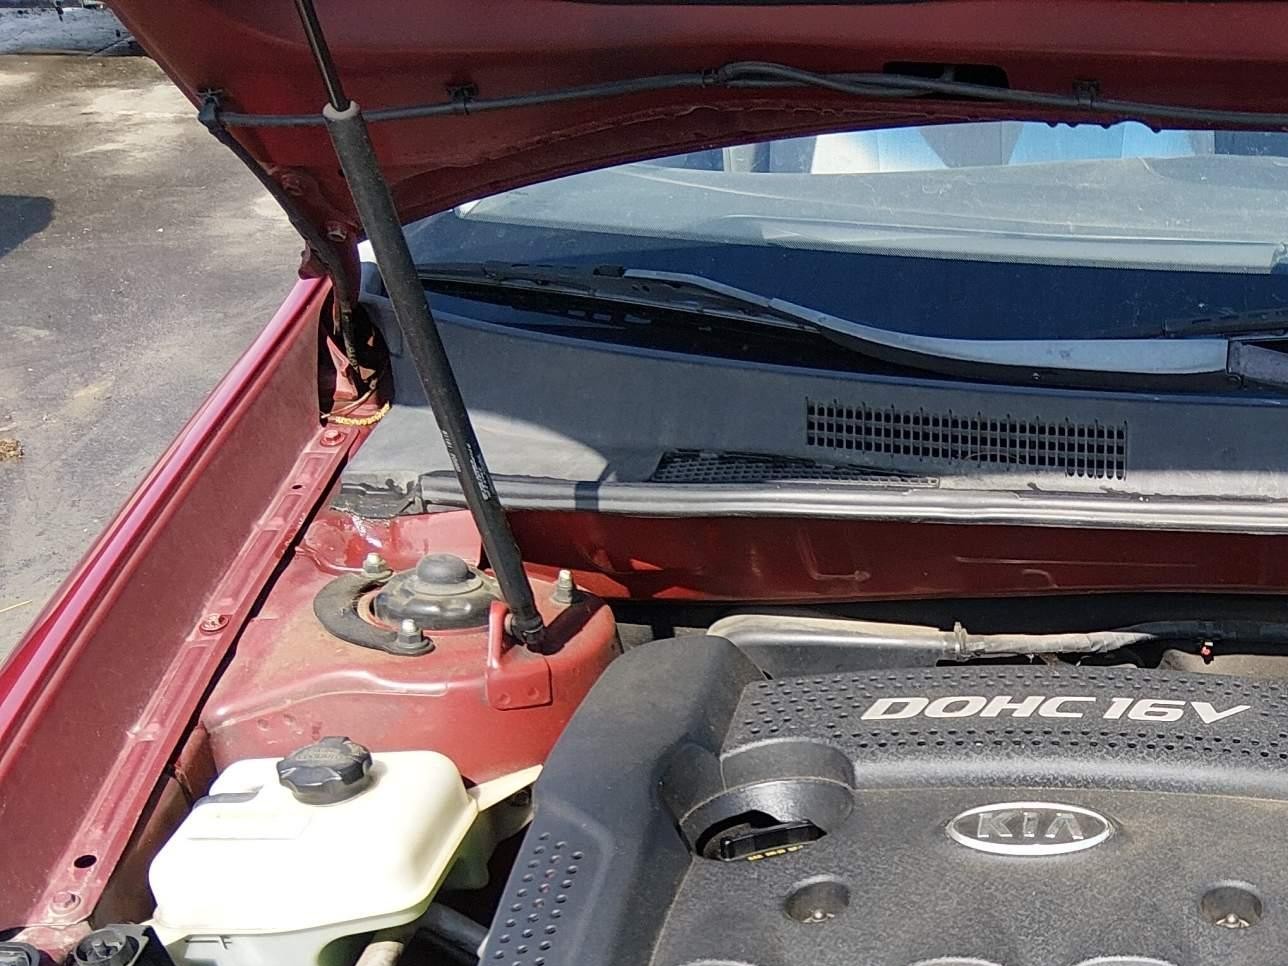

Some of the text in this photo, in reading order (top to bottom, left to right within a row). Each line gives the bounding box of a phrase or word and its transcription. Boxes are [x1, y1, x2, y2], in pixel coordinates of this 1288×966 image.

[860, 695, 1252, 724] DOHC 16V
[976, 811, 1084, 840] KIA
